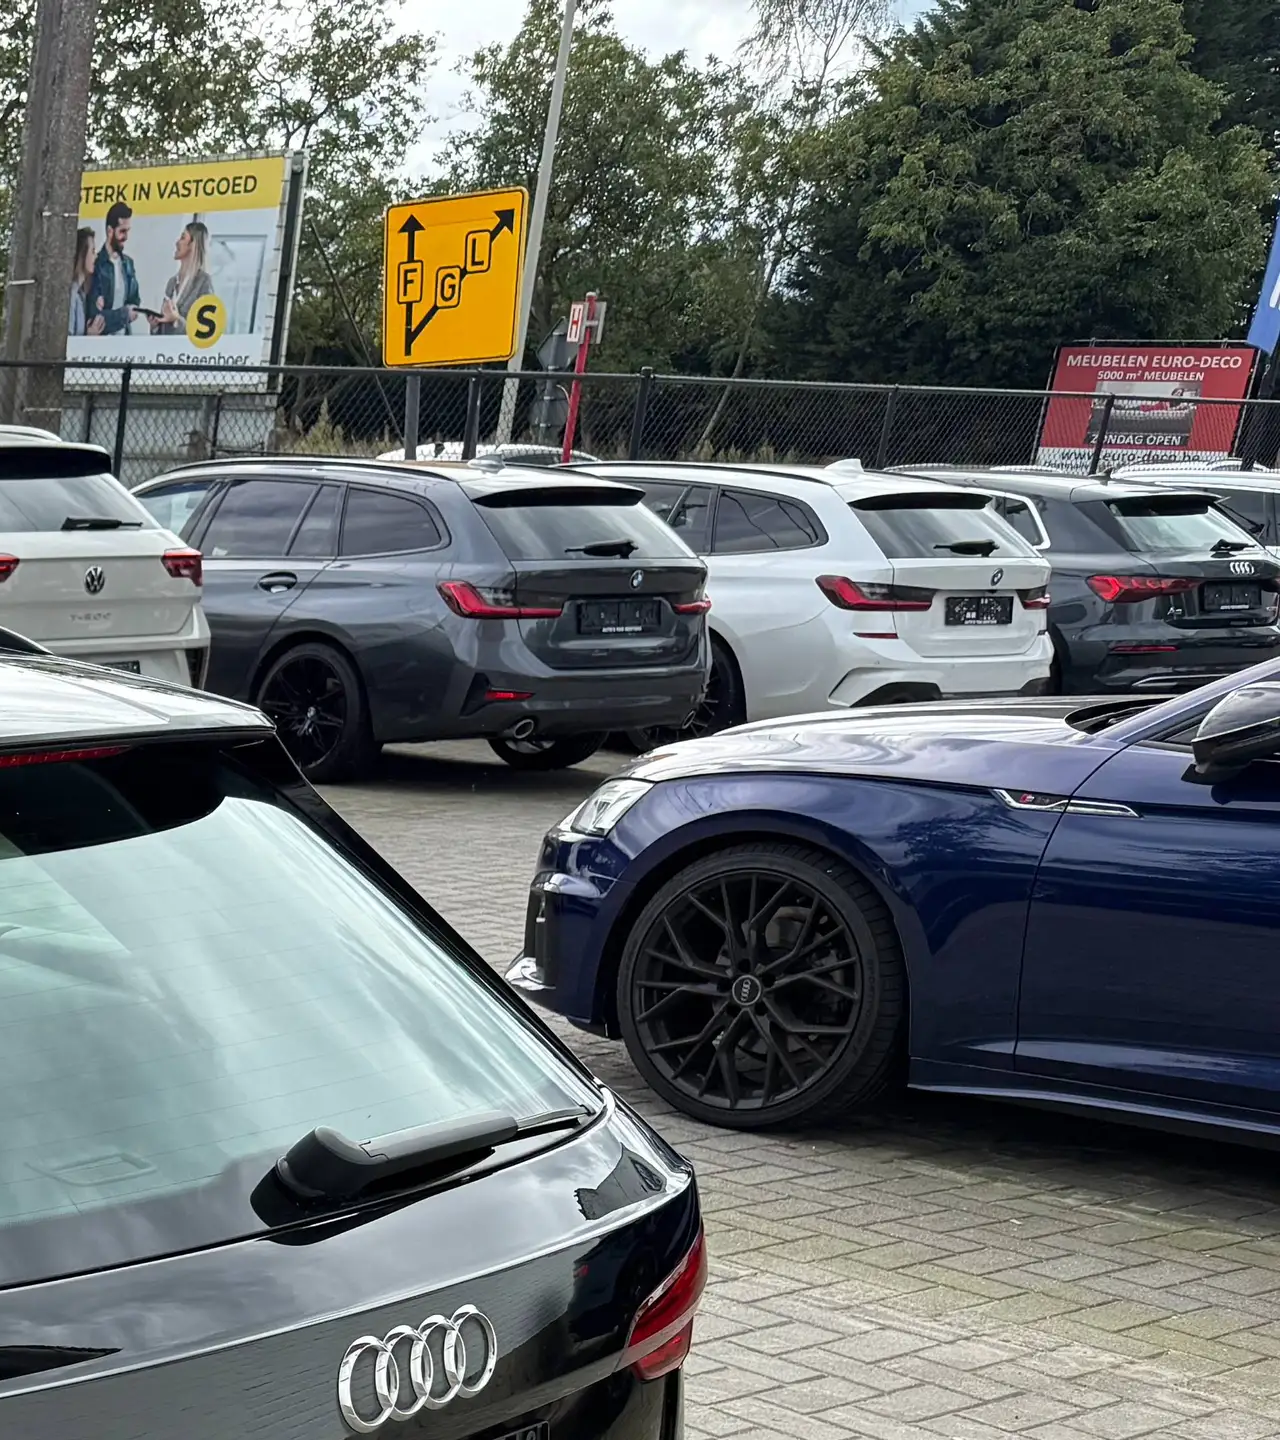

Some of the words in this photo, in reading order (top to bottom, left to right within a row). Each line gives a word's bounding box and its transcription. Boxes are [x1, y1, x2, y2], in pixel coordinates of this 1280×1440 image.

[80, 184, 128, 204] TERK
[132, 182, 152, 202] IN
[156, 175, 258, 200] VASTGOED
[471, 238, 484, 266] L
[403, 268, 418, 297] F
[440, 273, 456, 302] G
[194, 304, 218, 340] S
[1066, 354, 1149, 368] MEUBELEN
[1151, 355, 1243, 369] EURO-DECO
[1097, 370, 1123, 380] 5000
[1143, 371, 1205, 381] MEUBELEN
[1146, 434, 1182, 446] OPEN
